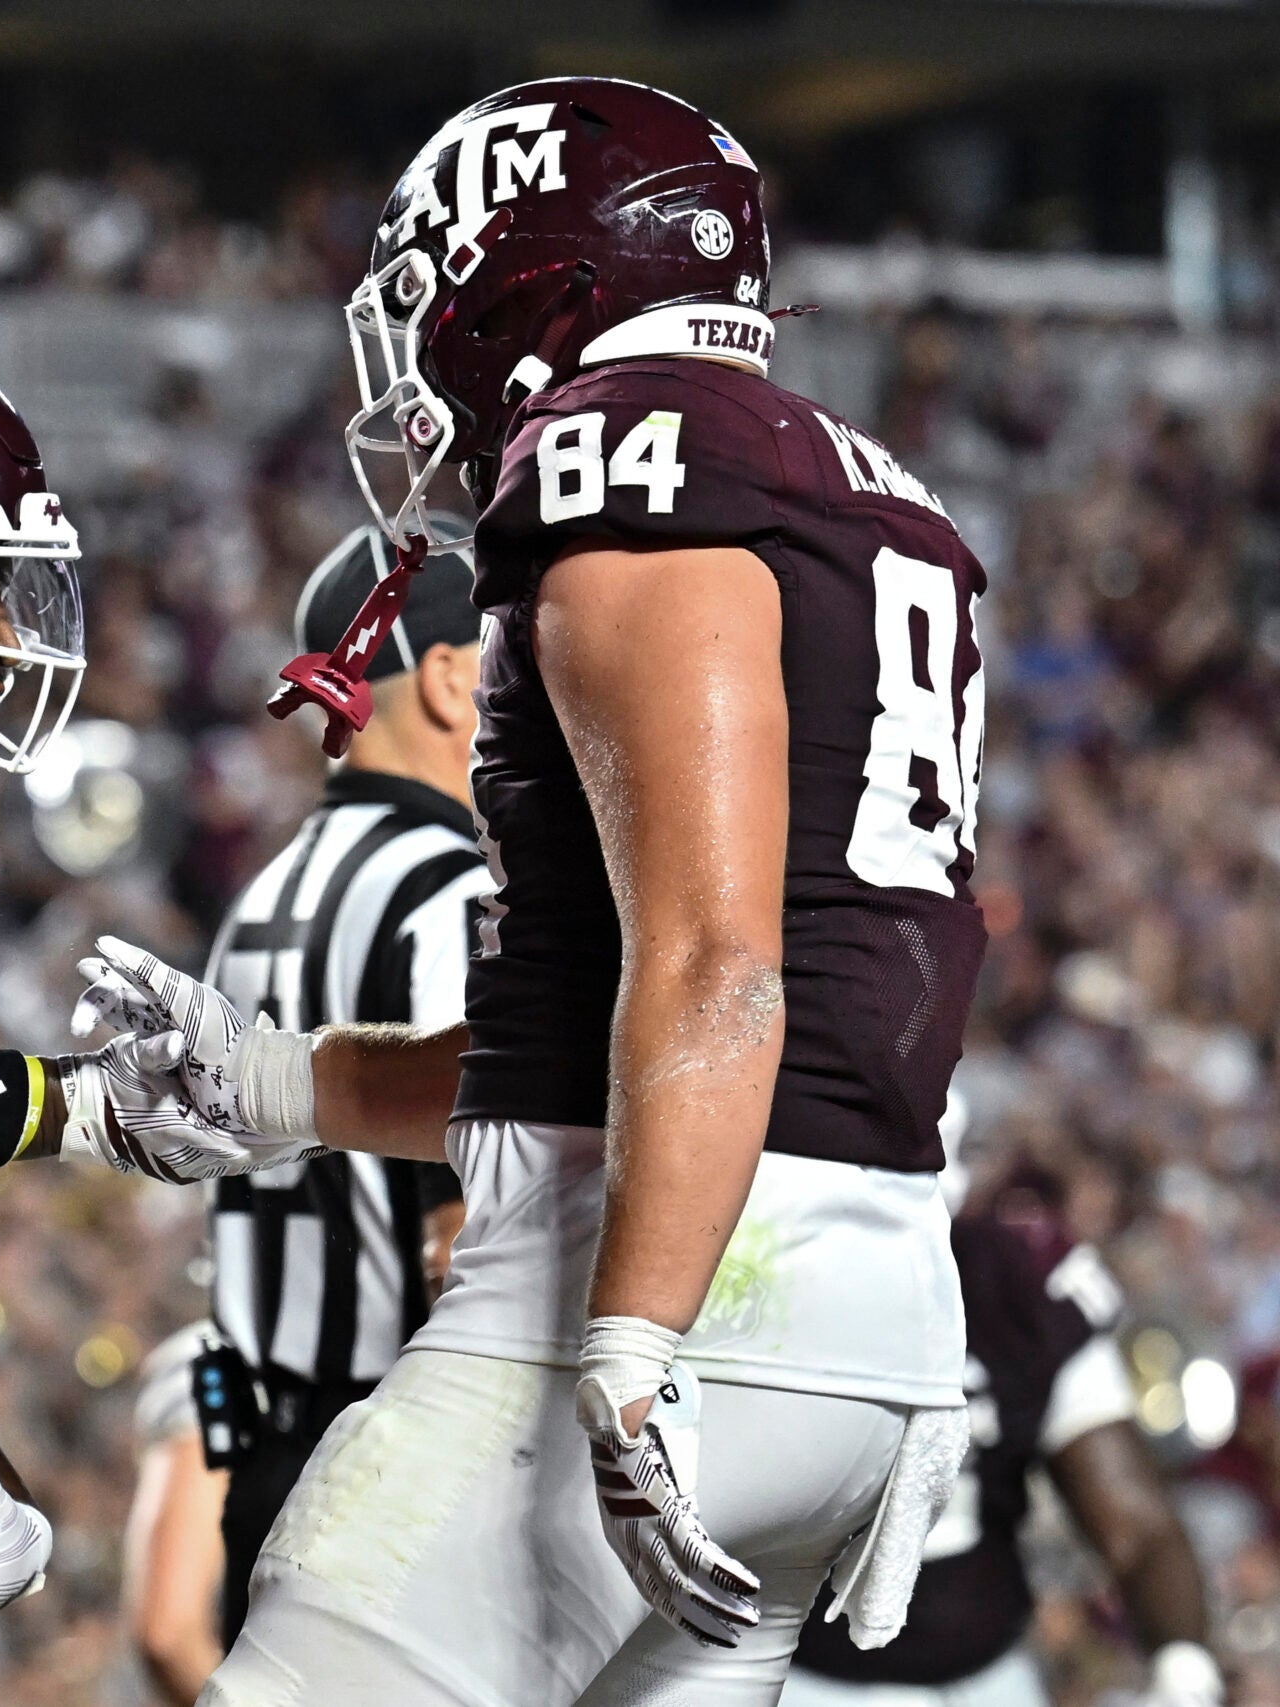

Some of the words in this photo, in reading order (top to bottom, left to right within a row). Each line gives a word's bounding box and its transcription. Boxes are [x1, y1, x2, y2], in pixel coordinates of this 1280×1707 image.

[695, 213, 731, 255] SEC
[737, 274, 761, 305] 84
[688, 319, 761, 353] TEXAS
[537, 410, 686, 525] 84
